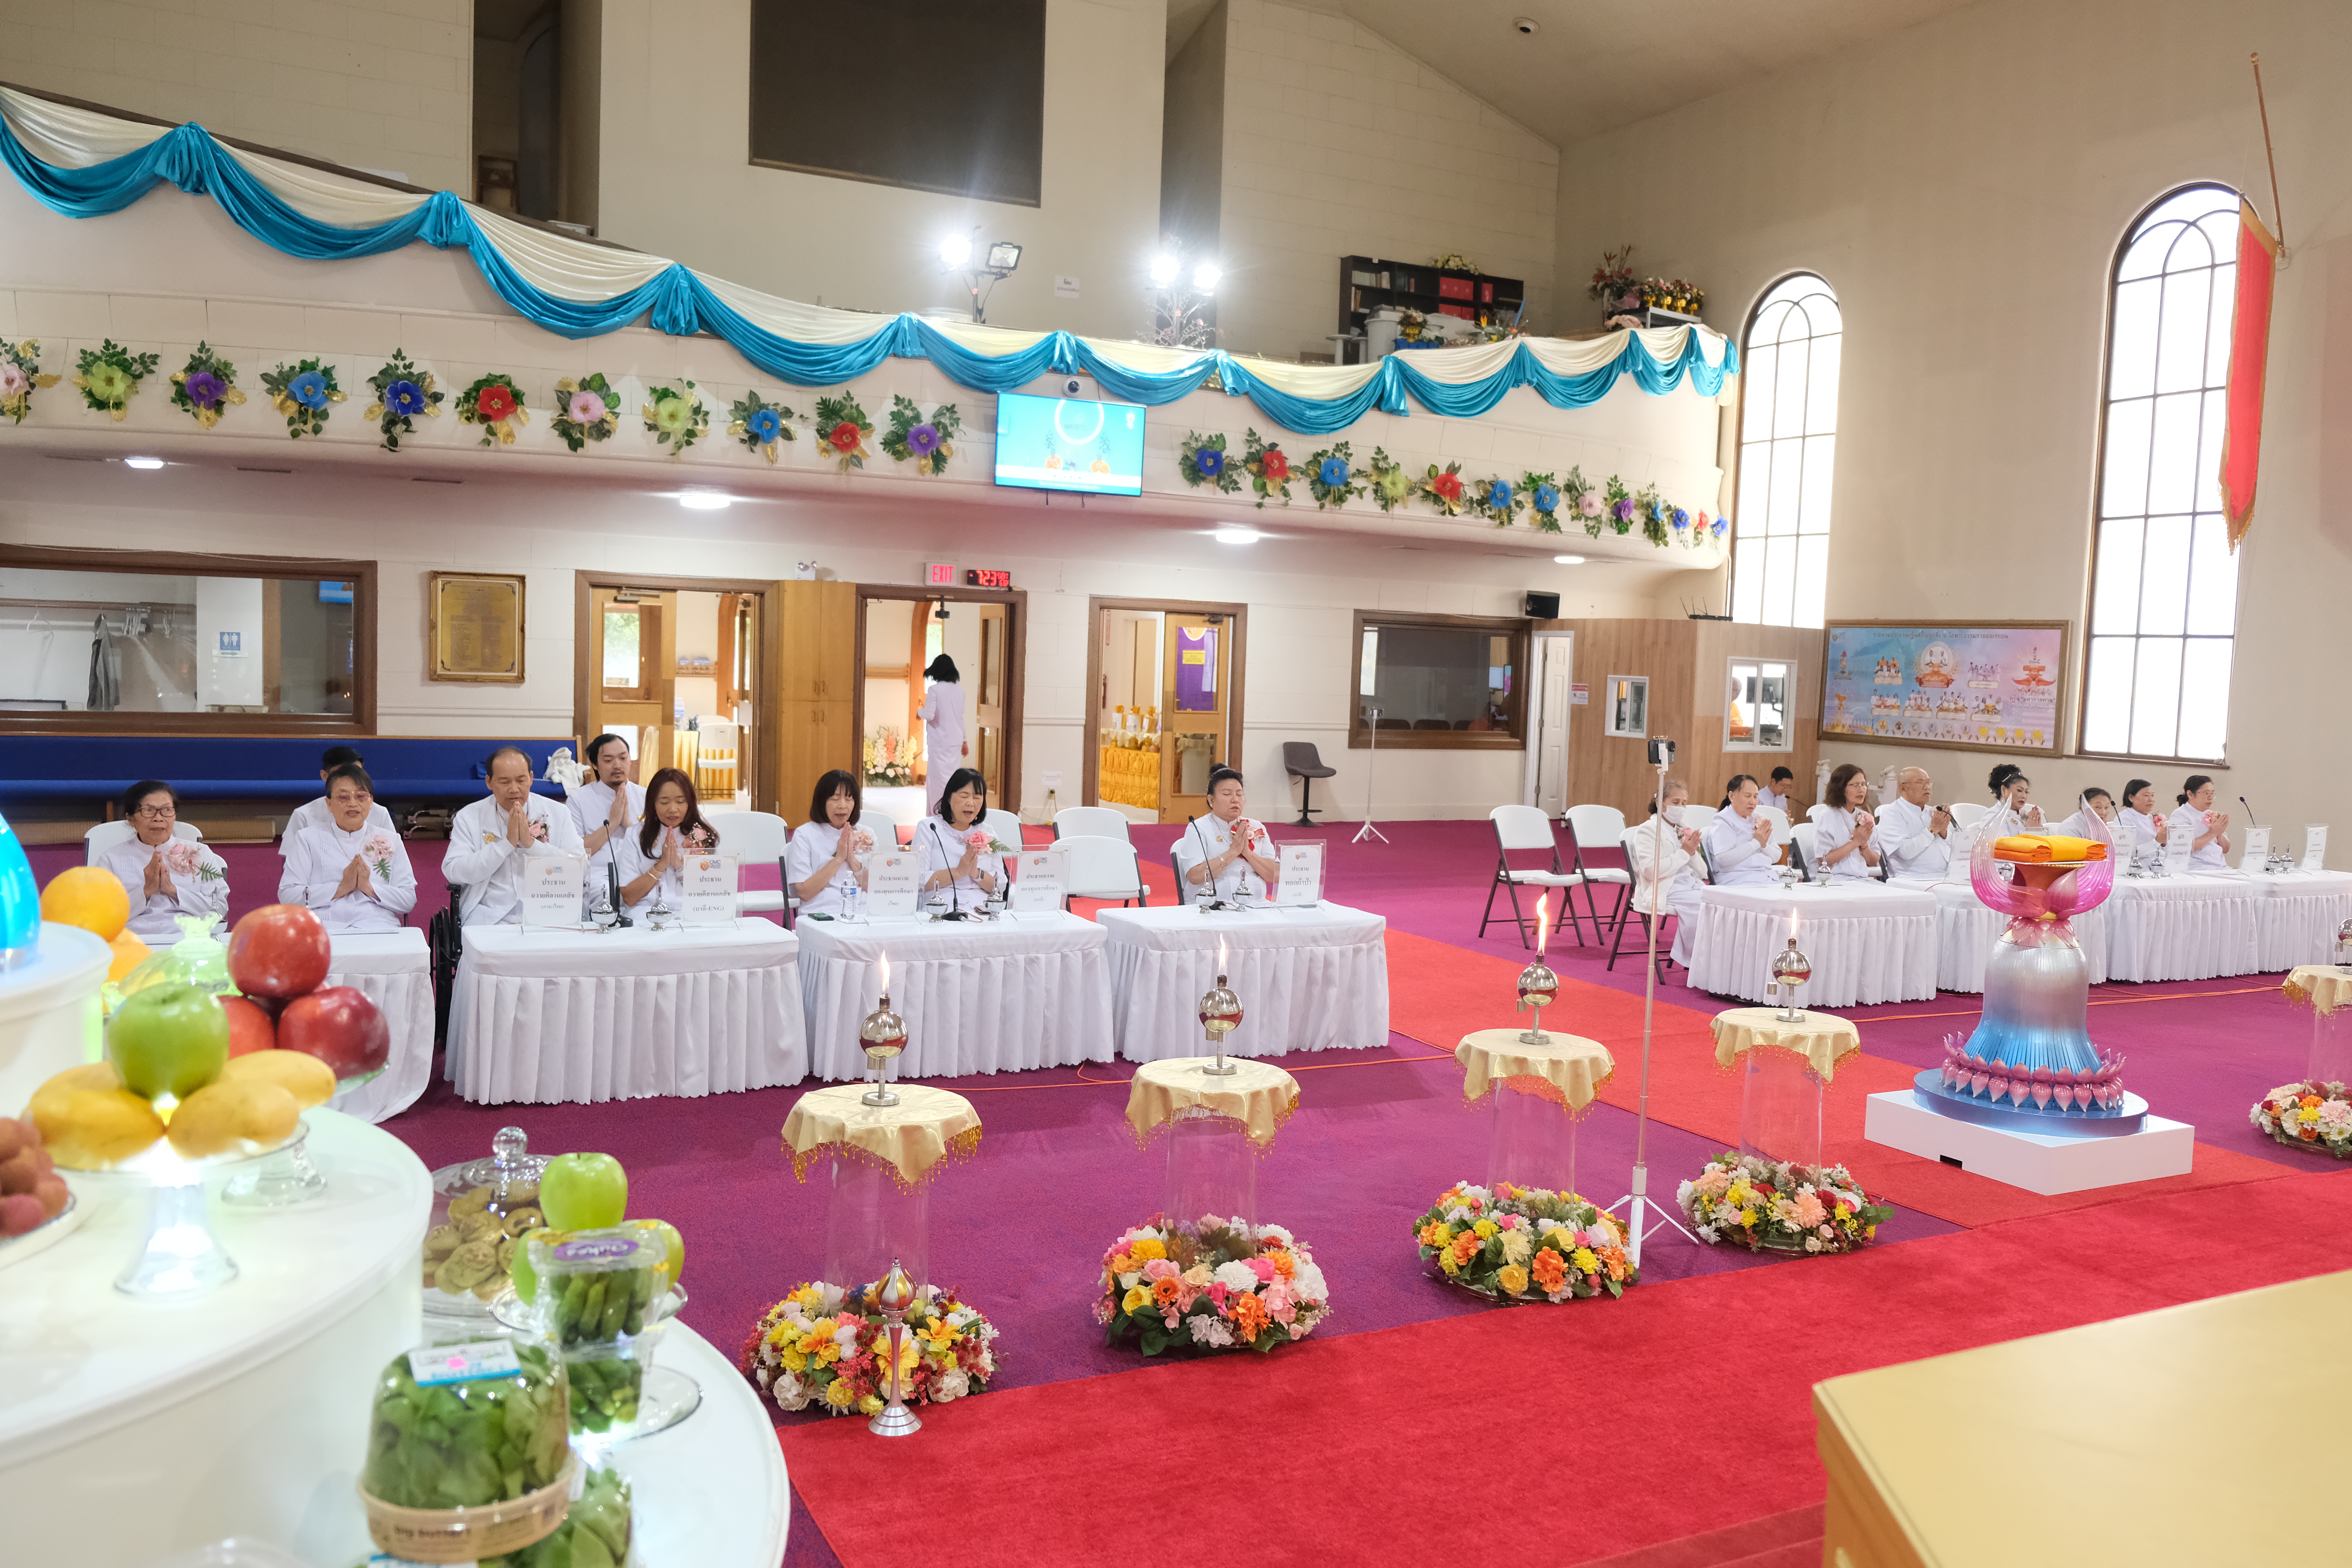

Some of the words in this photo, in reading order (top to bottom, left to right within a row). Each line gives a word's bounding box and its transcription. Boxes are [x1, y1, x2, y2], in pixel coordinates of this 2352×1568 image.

[932, 565, 954, 582] EXIT
[1285, 877, 1311, 886] ทอดผ้าป่า
